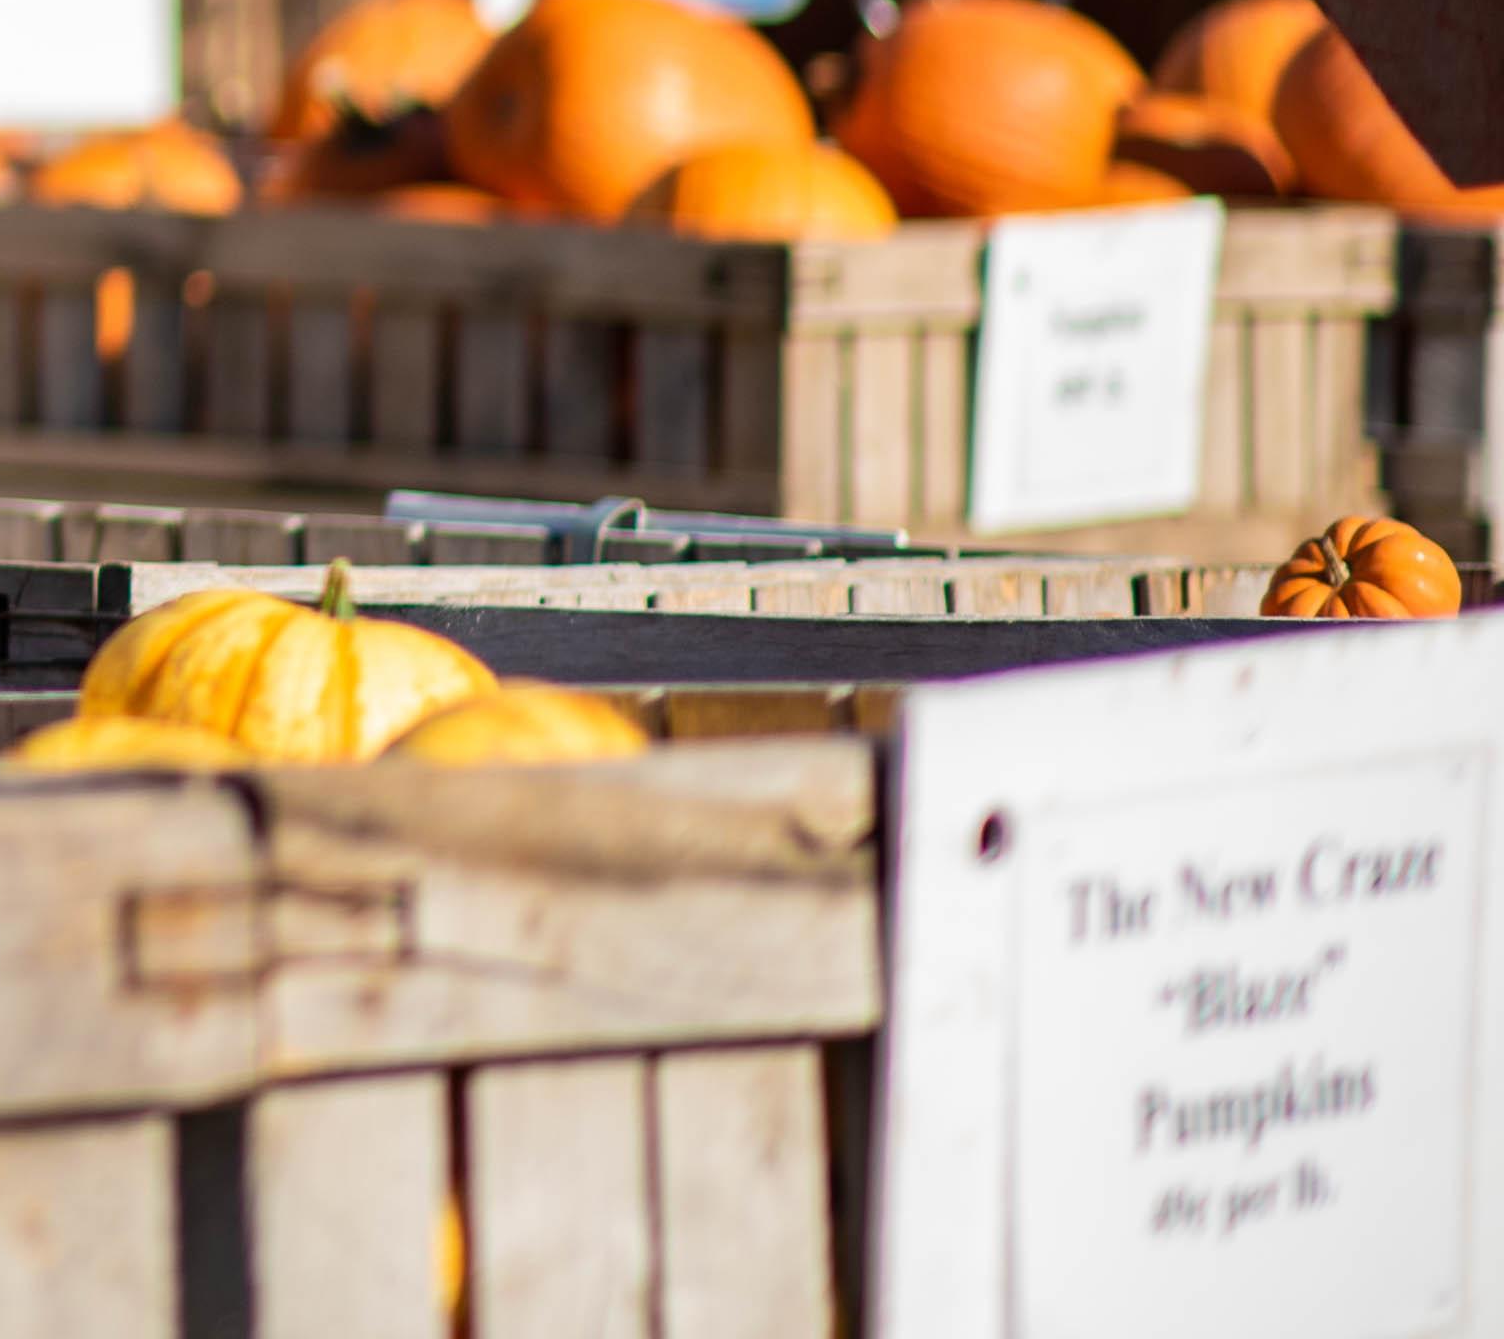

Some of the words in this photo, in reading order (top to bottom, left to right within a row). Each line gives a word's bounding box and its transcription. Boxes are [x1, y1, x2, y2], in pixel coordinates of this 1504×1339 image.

[1064, 874, 1156, 945] The
[1175, 859, 1278, 927] New
[1296, 835, 1446, 905] Craze
[1133, 1058, 1378, 1155] Pumpkins
[1219, 1178, 1280, 1242] per
